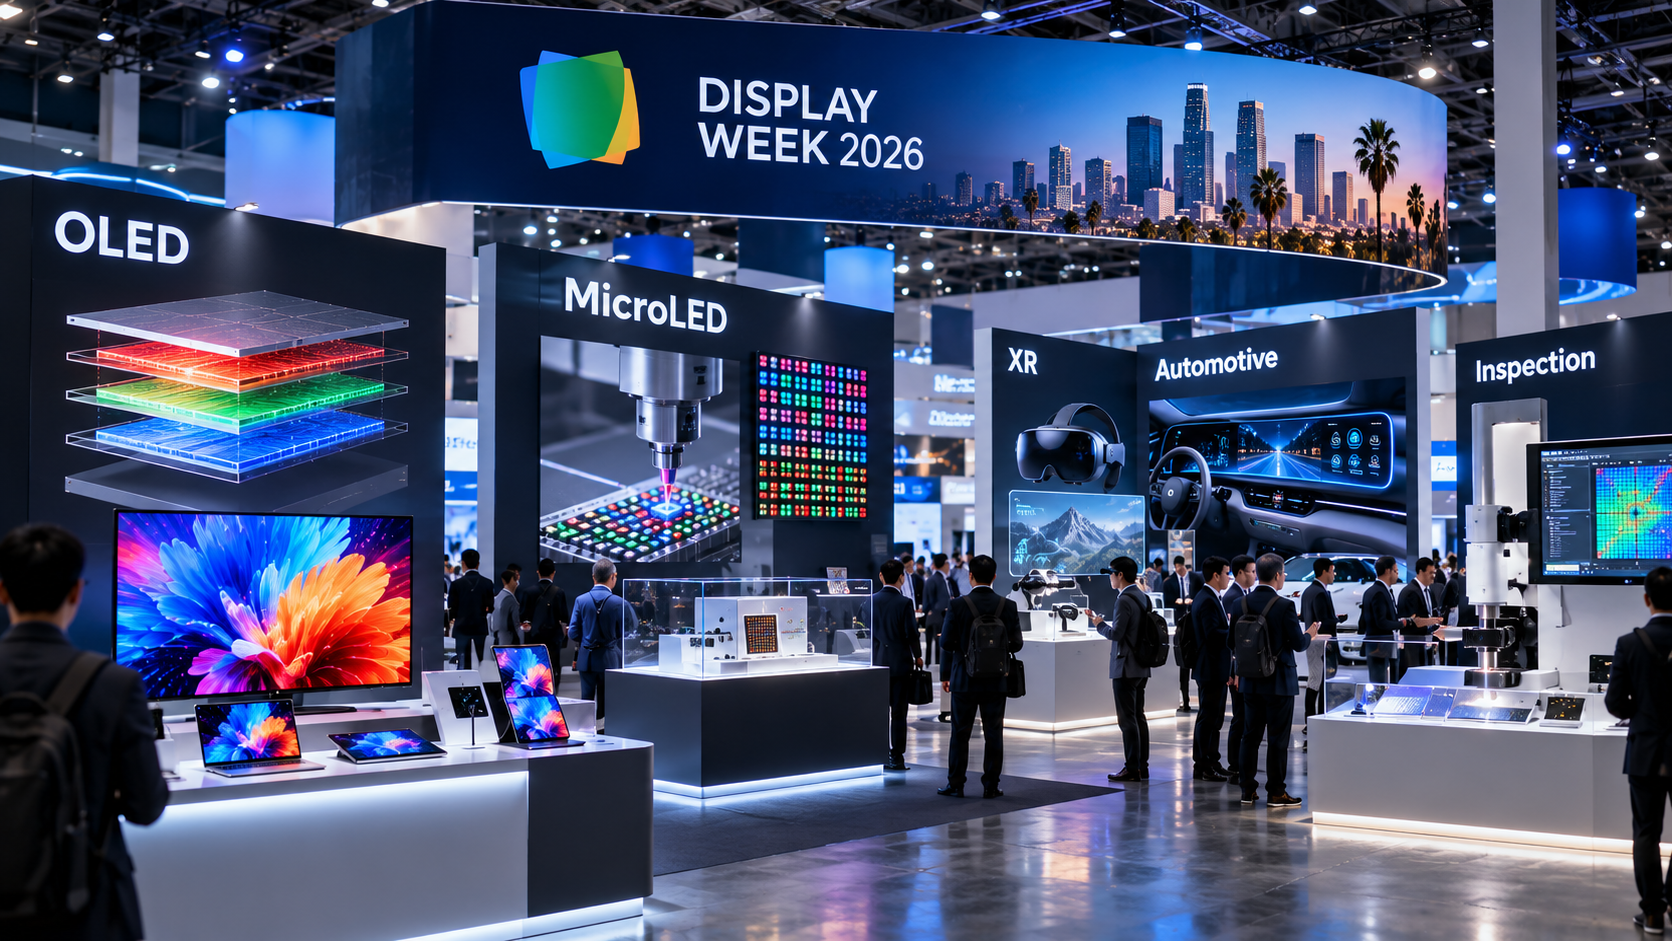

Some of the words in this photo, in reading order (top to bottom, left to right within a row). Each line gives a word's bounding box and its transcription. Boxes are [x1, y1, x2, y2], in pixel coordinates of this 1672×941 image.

[698, 76, 878, 124] DISPLAY
[697, 121, 830, 165] WEEK
[839, 132, 924, 171] 2026
[54, 210, 190, 265] OLED
[564, 276, 728, 334] MicroLED
[1007, 347, 1039, 375] XR
[1154, 346, 1279, 382] Automotive
[1476, 347, 1596, 385] Inspection
